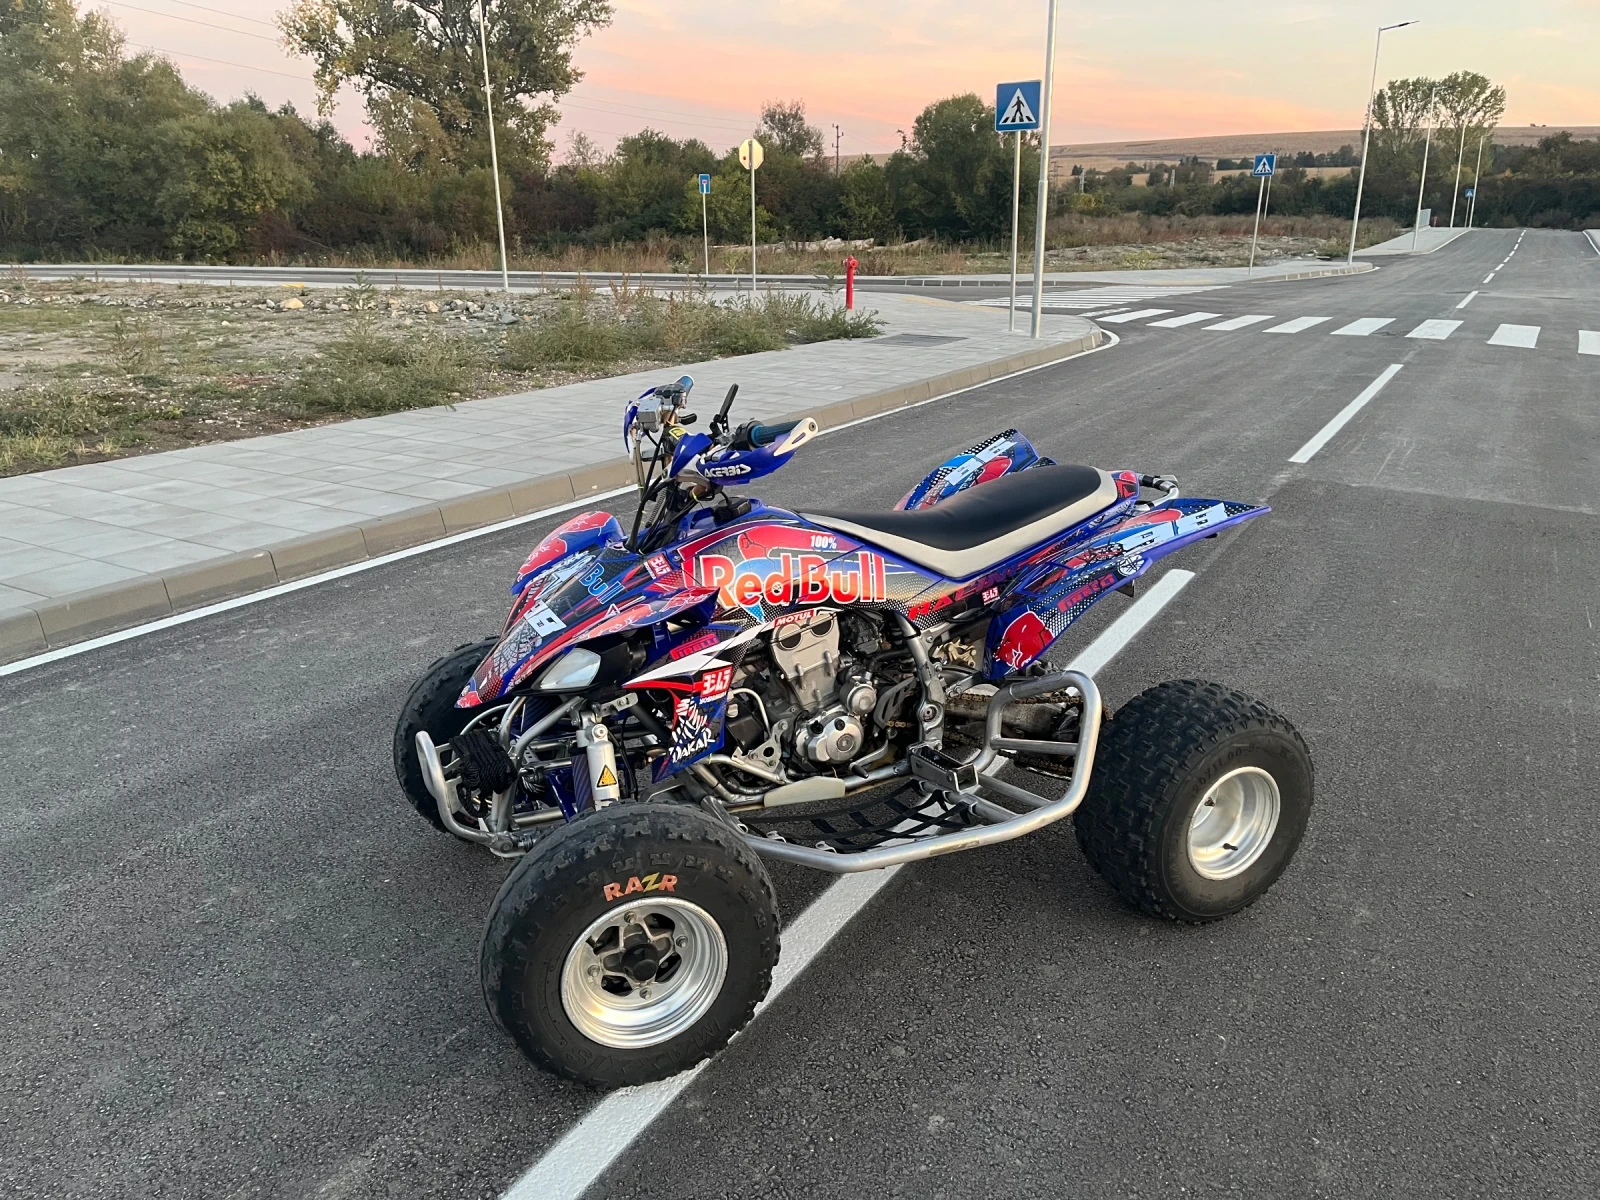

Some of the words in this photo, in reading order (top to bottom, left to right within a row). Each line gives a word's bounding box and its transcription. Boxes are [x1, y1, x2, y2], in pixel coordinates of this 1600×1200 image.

[809, 534, 837, 550] 100%
[578, 562, 626, 605] Bull
[699, 552, 793, 608] Red
[797, 551, 888, 605] Bull
[776, 610, 813, 626] MOTUL
[668, 727, 716, 763] DAKAR
[603, 872, 678, 901] RAZR
[566, 1017, 721, 1075] MAXXIS
